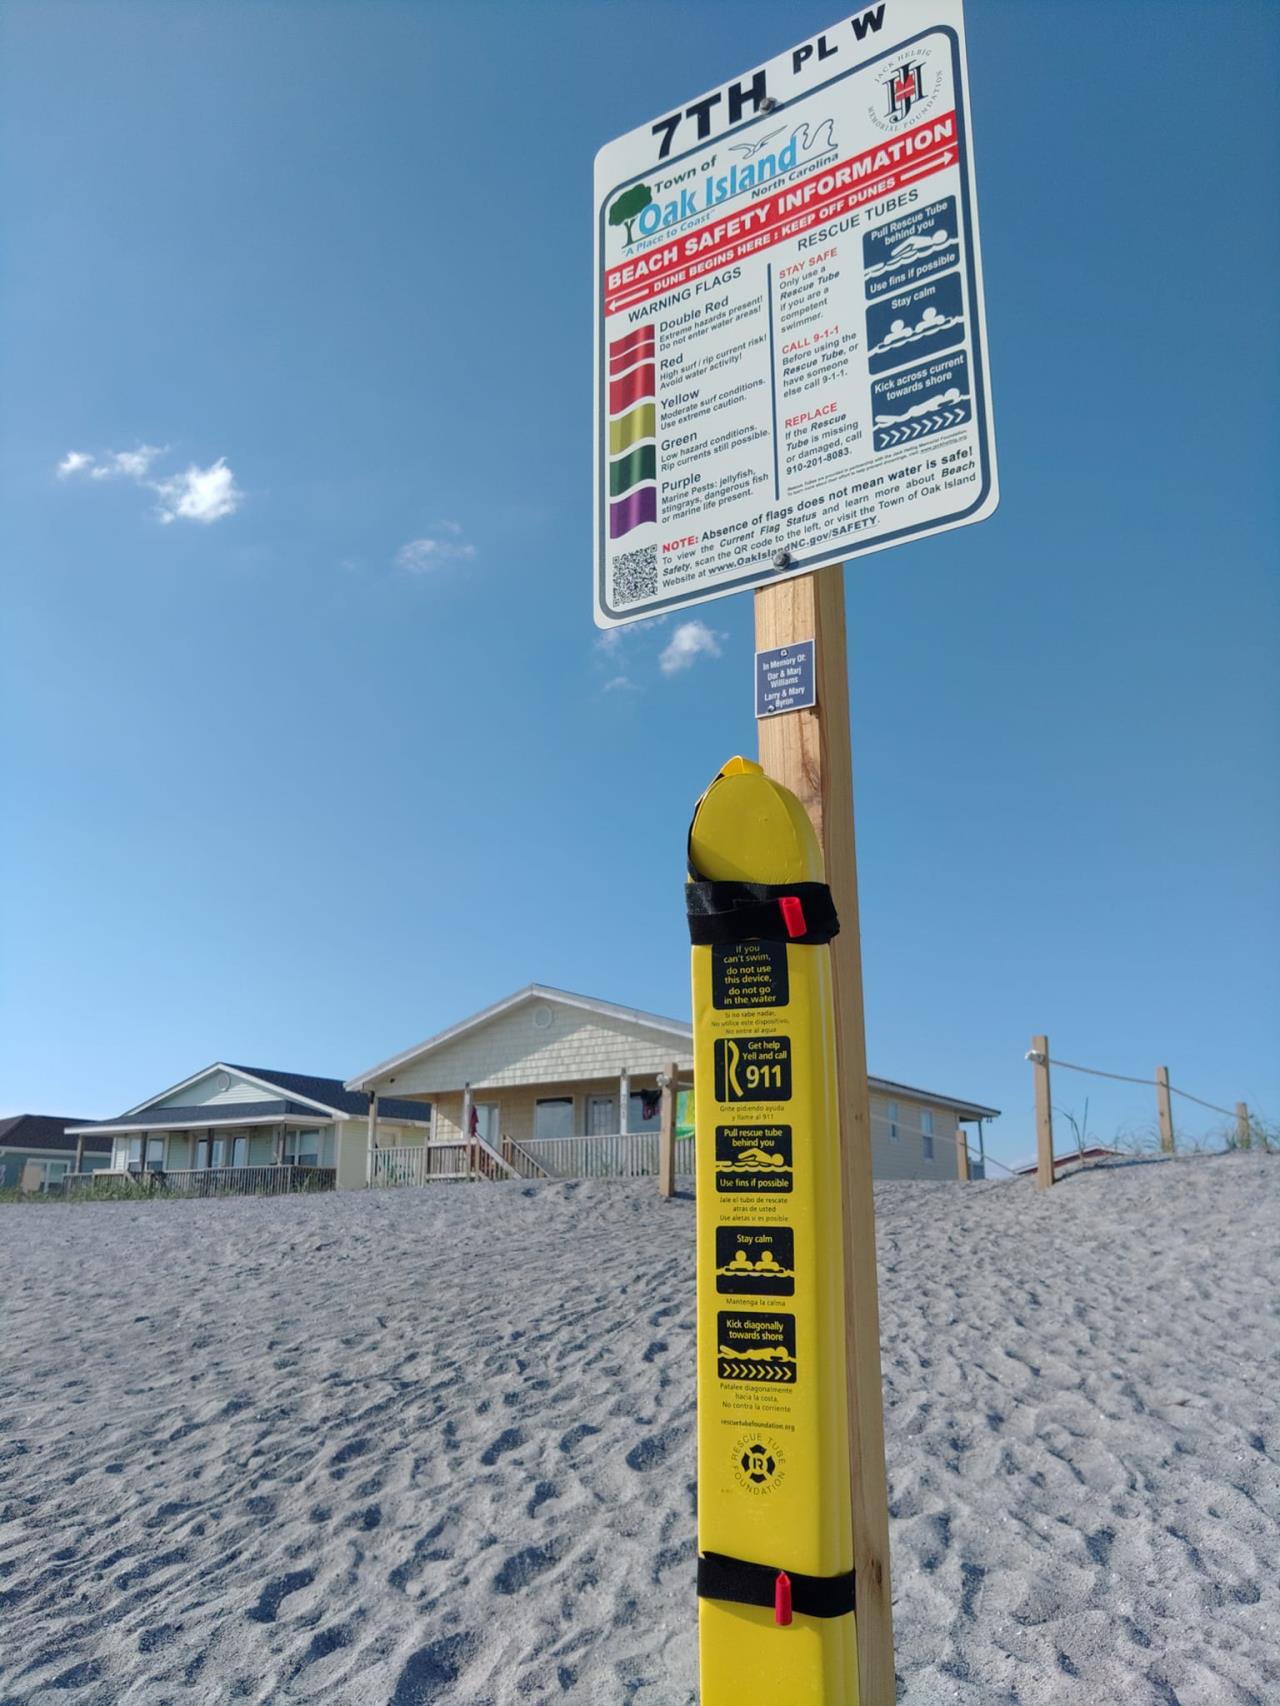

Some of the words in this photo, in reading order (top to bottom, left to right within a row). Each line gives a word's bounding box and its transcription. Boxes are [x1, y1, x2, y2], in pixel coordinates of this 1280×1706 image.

[652, 69, 767, 160] 7TH
[792, 36, 838, 74] PL
[851, 3, 885, 41] W
[874, 63, 894, 83] JACK
[868, 106, 897, 131] MEMORIAL
[904, 70, 942, 128] FOUNDATION
[639, 189, 697, 235] Oak
[706, 134, 797, 206] Island
[654, 168, 696, 194] Town
[701, 154, 717, 171] of
[751, 178, 785, 199] North
[789, 153, 839, 181] Carolina
[608, 246, 678, 290] BEACH
[685, 202, 770, 256] SAFETY
[779, 120, 952, 215] INFORMATION
[798, 214, 860, 251] RESCUE
[865, 189, 918, 220] TUBES
[871, 227, 888, 240] Pull
[890, 213, 923, 232] Rescue
[925, 202, 947, 216] Tube
[637, 235, 663, 251] Place
[667, 228, 678, 238] to
[654, 271, 686, 292] DUNE
[689, 252, 734, 276] BEGINS
[738, 234, 770, 256] HERE
[782, 214, 815, 237] KEEP
[820, 201, 844, 219] OFF
[849, 177, 895, 206] DUNES
[885, 227, 915, 245] behind
[917, 219, 934, 234] you
[780, 262, 805, 278] STAY
[809, 248, 837, 267] SAFE
[870, 282, 887, 293] Use
[890, 275, 905, 286] fins
[916, 254, 955, 277] possible
[629, 289, 691, 323] WARNING
[696, 267, 741, 294] FLAGS
[780, 282, 814, 300] Rescue
[818, 271, 839, 285] Tube
[891, 296, 911, 309] Stay
[914, 286, 935, 300] calm
[660, 310, 701, 332] Double
[706, 296, 728, 313] Red
[781, 298, 827, 322] competent
[660, 326, 692, 343] Extreme
[695, 312, 726, 328] hazards
[781, 313, 823, 333] swimmer.
[716, 342, 746, 359] current
[782, 338, 810, 354] CALL
[814, 326, 839, 343] 9-1-1
[661, 354, 683, 370] Red
[783, 350, 811, 365] Before
[815, 340, 839, 353] using
[783, 359, 817, 376] Rescue
[807, 358, 848, 379] someone
[875, 381, 894, 394] Kick
[897, 370, 927, 386] across
[930, 355, 963, 373] current
[887, 382, 923, 400] towards
[926, 372, 952, 386] shore
[661, 404, 698, 421] Moderate
[719, 378, 765, 399] conditions.
[661, 390, 699, 410] Yellow
[678, 408, 711, 424] extreme
[785, 402, 838, 429] REPLACE
[810, 414, 846, 431] Rescue
[661, 432, 697, 451] Green
[680, 441, 708, 456] hazard
[710, 425, 757, 446] conditions.
[786, 438, 809, 451] Tube
[822, 421, 858, 438] missing
[677, 450, 711, 466] currents
[662, 473, 701, 493] Purple
[705, 479, 750, 500] dangerous
[662, 491, 688, 504] Marine
[663, 536, 699, 553] NOTE:
[702, 521, 748, 542] Absence
[752, 514, 763, 526] of
[766, 506, 793, 521] flags
[797, 496, 824, 511] does
[829, 488, 848, 501] not
[852, 476, 884, 494] mean
[888, 464, 923, 482] water
[941, 446, 973, 465] safe!
[677, 550, 696, 560] view
[720, 530, 754, 548] Current
[760, 523, 780, 536] Flag
[787, 511, 816, 527] Status
[822, 503, 839, 515] and
[845, 495, 869, 508] learn
[875, 486, 900, 498] more
[906, 474, 934, 489] about
[942, 461, 975, 478] Beach
[663, 562, 692, 576] Safety,
[695, 556, 715, 566] scan
[751, 538, 772, 550] code
[775, 534, 784, 543] to
[837, 511, 857, 522] visit
[879, 497, 904, 509] Town
[921, 484, 941, 496] Oak
[945, 473, 976, 489] Island
[663, 573, 695, 588] Website
[770, 658, 795, 668] Memory
[771, 677, 798, 687] Williams
[765, 692, 780, 701] Larry
[789, 687, 805, 695] Mary
[723, 955, 744, 963] can't
[744, 946, 760, 954] you
[725, 976, 739, 984] this
[742, 975, 771, 983] device,
[735, 996, 748, 1004] the
[764, 1041, 780, 1050] help
[775, 1051, 787, 1059] call
[746, 1065, 781, 1088] 911
[765, 1128, 782, 1136] tube
[758, 1179, 789, 1188] possible
[737, 1235, 753, 1244] Stay
[755, 1235, 772, 1243] calm
[727, 1320, 741, 1328] Kick
[744, 1321, 783, 1332] diagonally
[729, 1331, 760, 1339] towards
[762, 1332, 783, 1340] shore
[731, 1434, 761, 1461] RESCUE
[767, 1438, 785, 1464] TUBE
[734, 1466, 784, 1495] FOUNDATION
